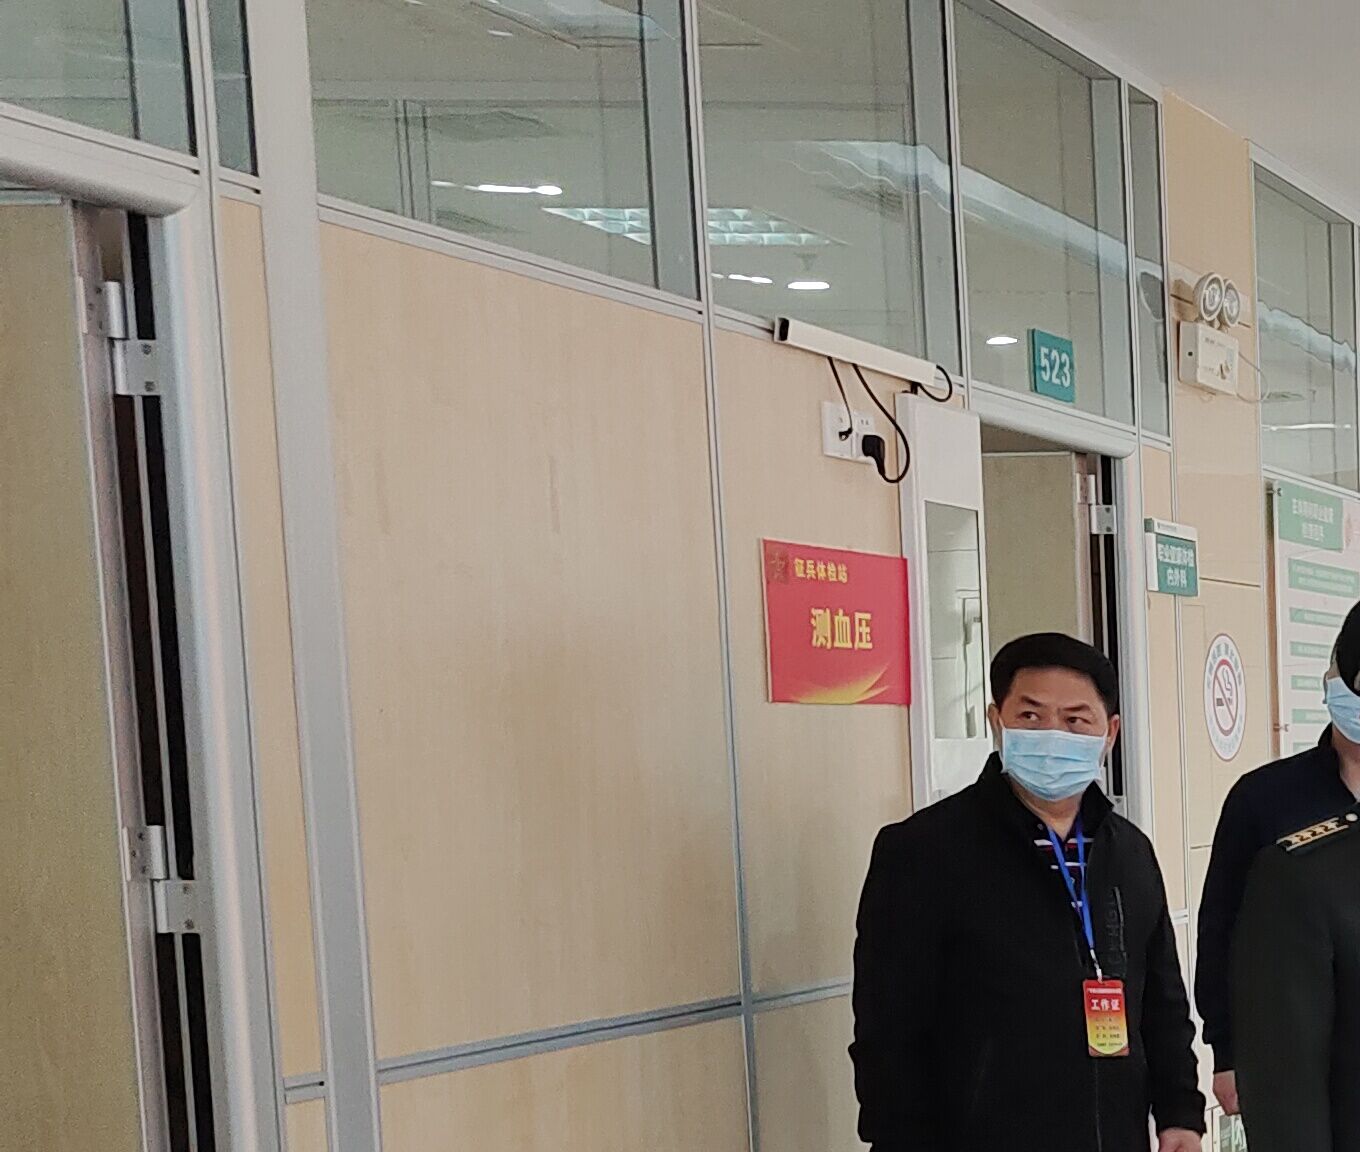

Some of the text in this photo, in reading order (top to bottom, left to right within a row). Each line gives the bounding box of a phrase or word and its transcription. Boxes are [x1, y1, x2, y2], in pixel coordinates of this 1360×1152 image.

[1040, 346, 1071, 388] 523
[793, 557, 848, 583] 征兵体检站
[810, 607, 873, 650] 测血压
